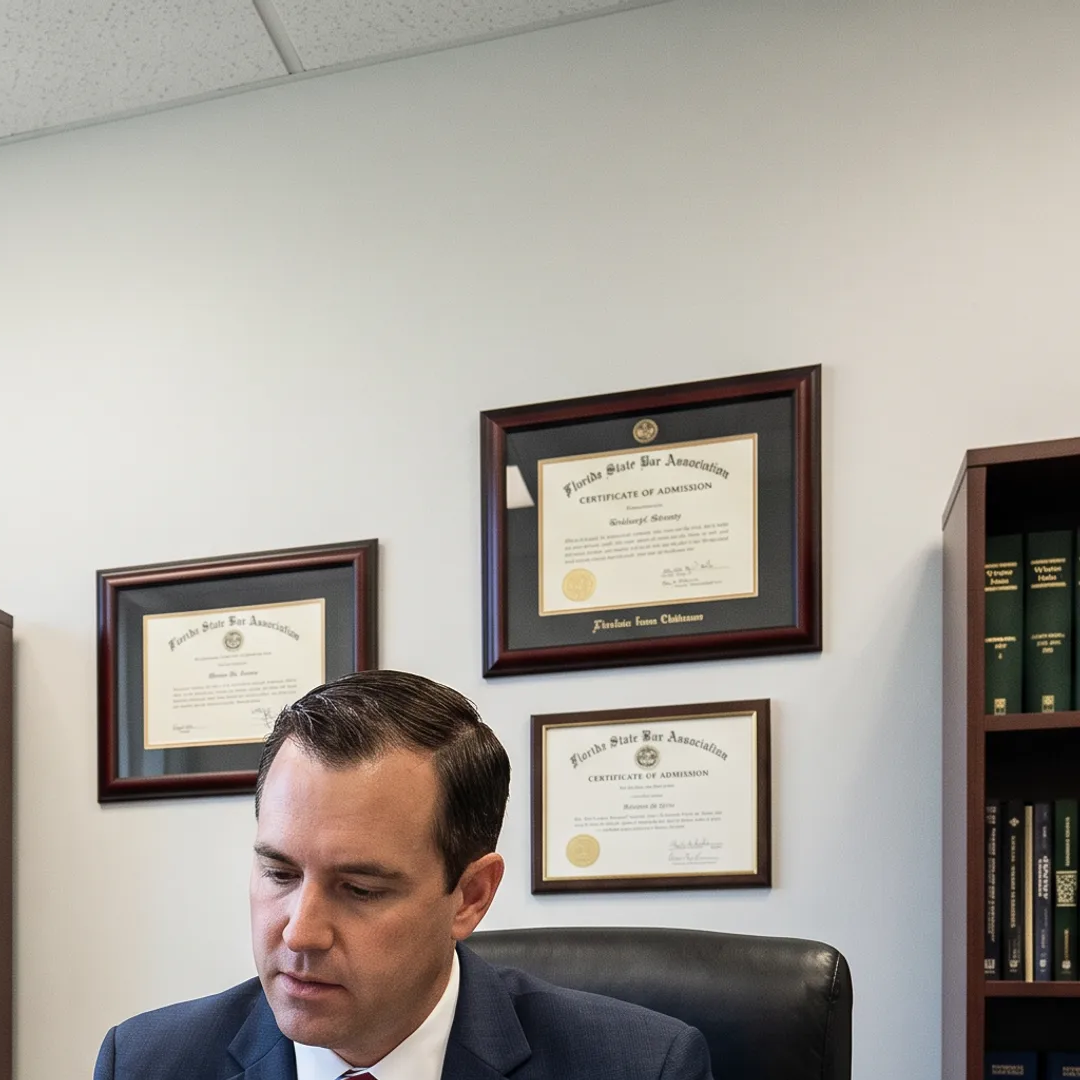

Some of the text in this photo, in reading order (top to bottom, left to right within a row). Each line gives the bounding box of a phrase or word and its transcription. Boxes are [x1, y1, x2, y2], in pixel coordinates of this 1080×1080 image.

[579, 482, 713, 505] CERTIFICATE OF ADMISSION
[609, 733, 639, 749] State
[642, 729, 664, 742] Bar
